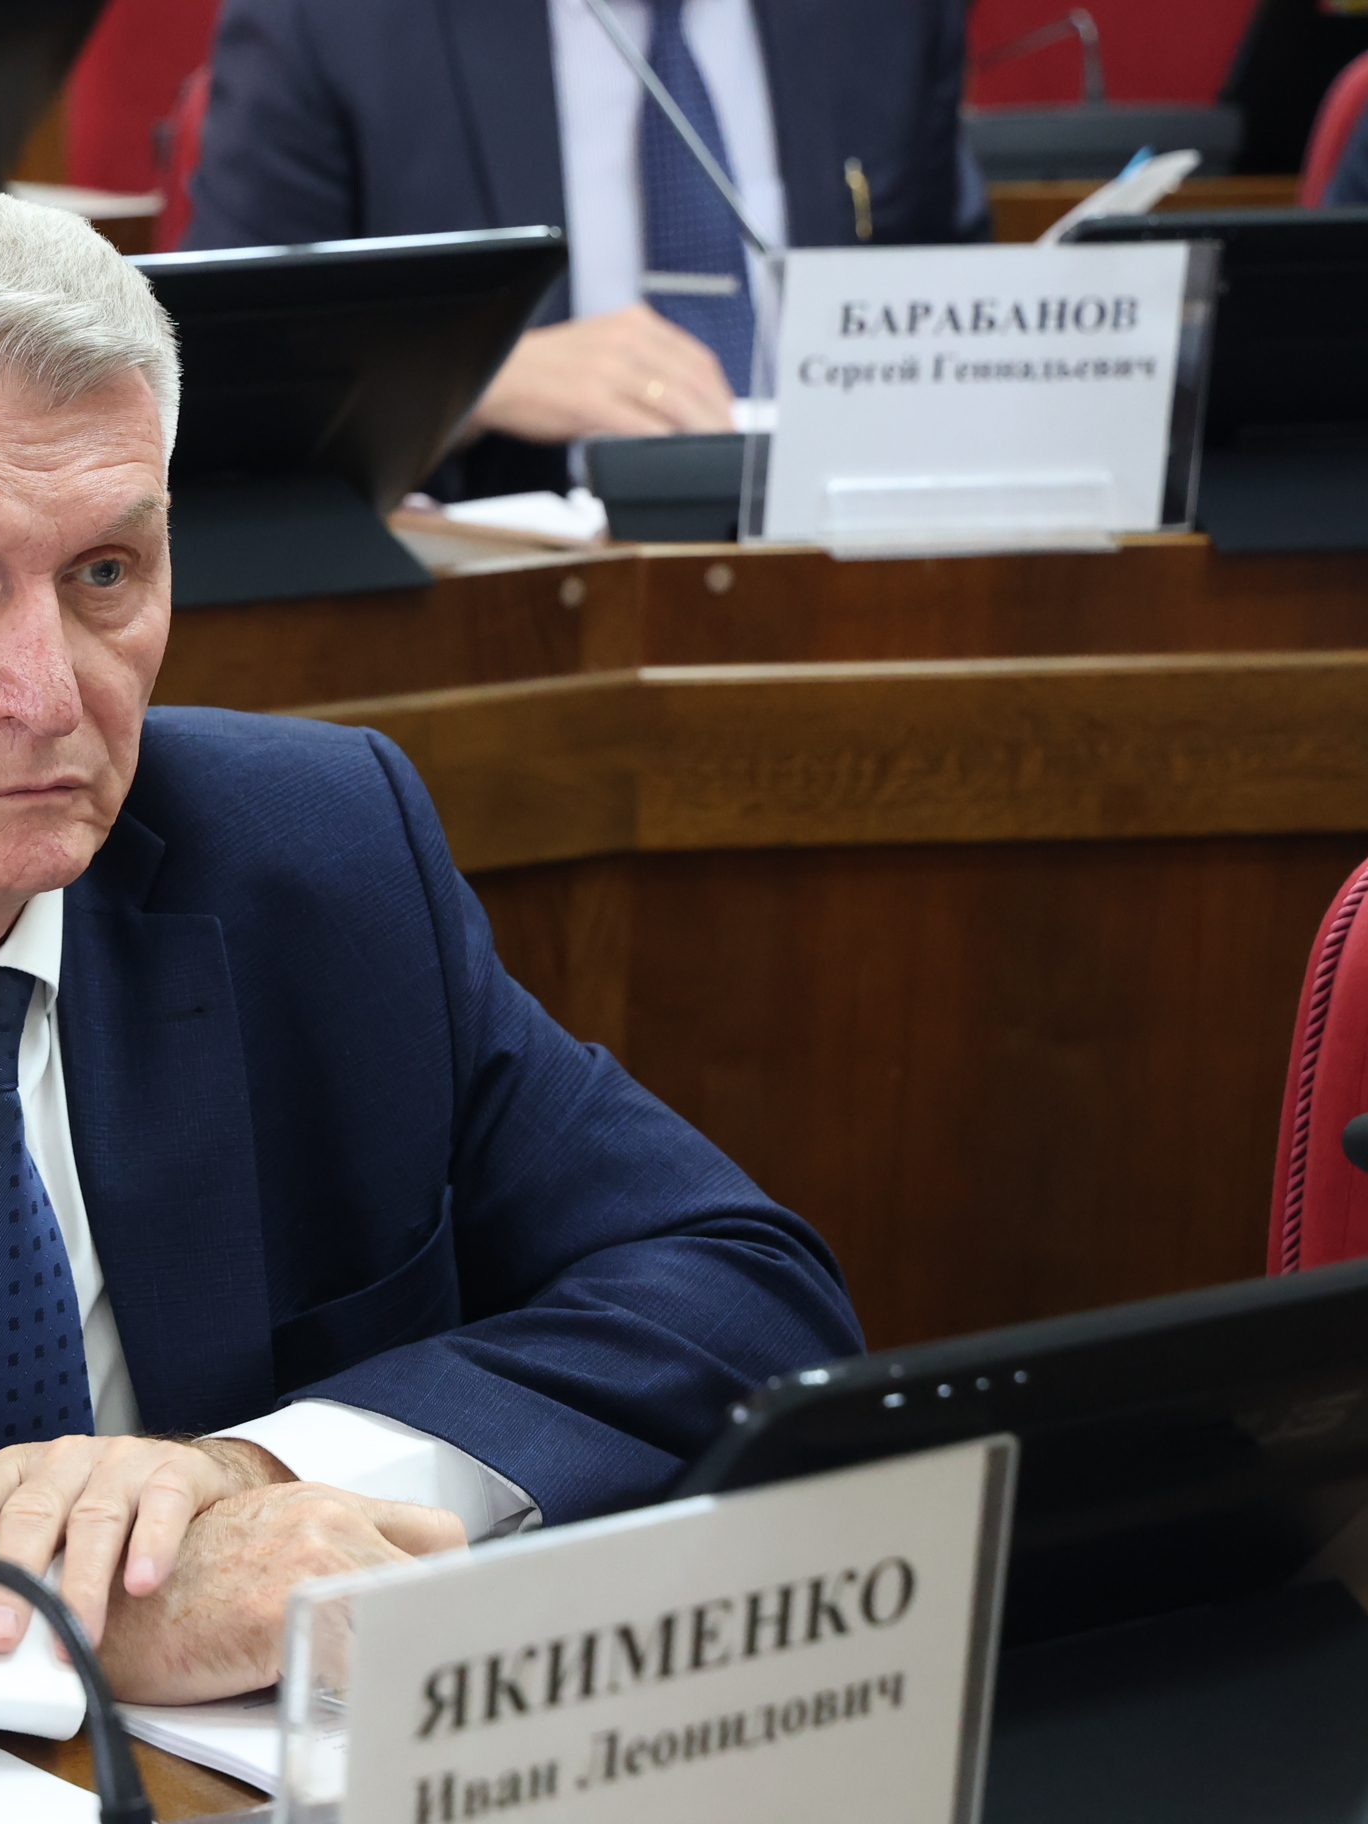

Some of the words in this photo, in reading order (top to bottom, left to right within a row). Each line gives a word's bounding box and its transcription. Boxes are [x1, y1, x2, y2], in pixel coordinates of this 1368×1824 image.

[839, 296, 1138, 336] БАРАБАНОВ
[799, 353, 919, 392] Сергей
[932, 350, 1156, 382] Геннадьевич
[415, 1555, 917, 1741] ЯКИМЕНКО
[413, 1759, 559, 1824] Иван
[575, 1671, 907, 1790] Леонидович
